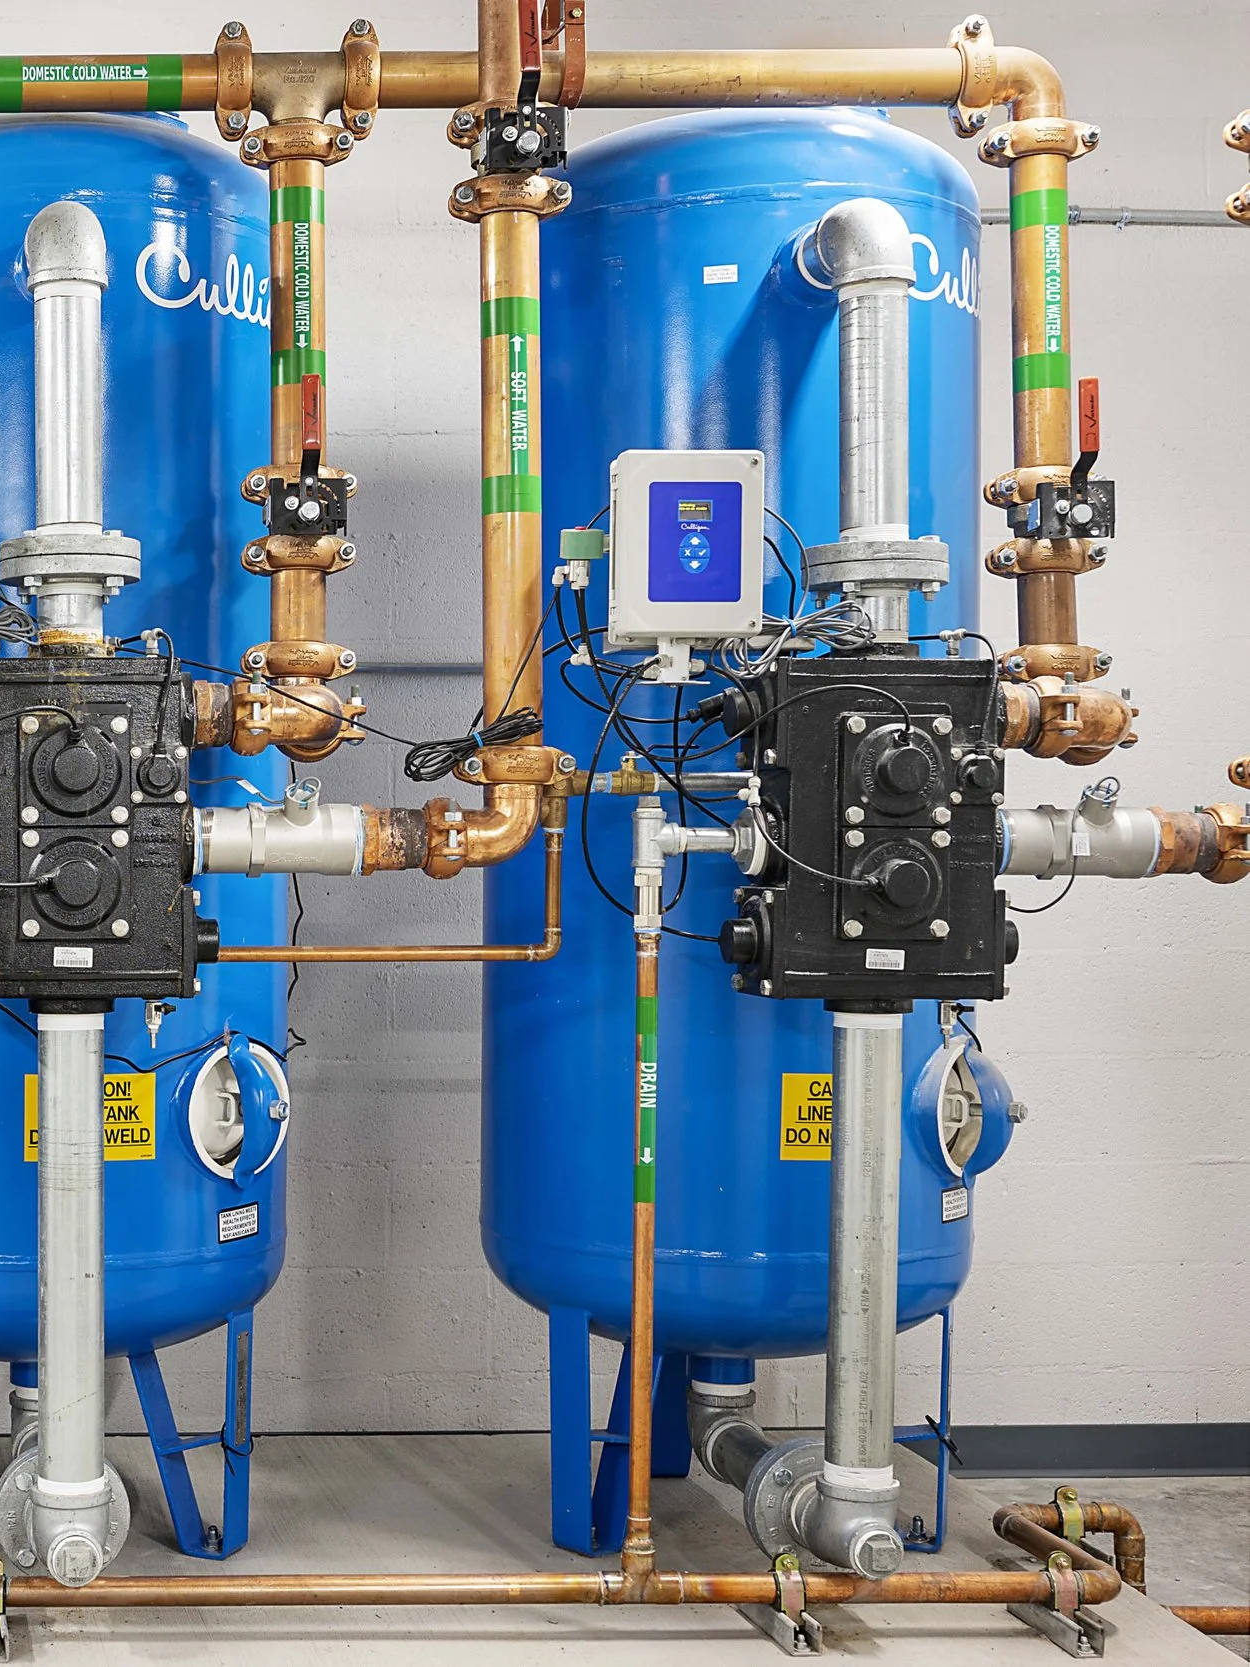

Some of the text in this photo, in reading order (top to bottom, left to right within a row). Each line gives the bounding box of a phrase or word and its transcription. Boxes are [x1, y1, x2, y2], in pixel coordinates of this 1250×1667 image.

[22, 66, 132, 81] DOMESTIC COLD WATER
[136, 242, 270, 330] Culli
[294, 223, 309, 333] DOMESTIC COLD WATER
[1045, 225, 1061, 336] DOMESTIC COLD WATER
[511, 372, 527, 450] SOFT WATER
[640, 1062, 657, 1108] DRAIN
[104, 1128, 150, 1144] WELD
[786, 1128, 811, 1144] DO
[798, 1105, 832, 1121] LINE
